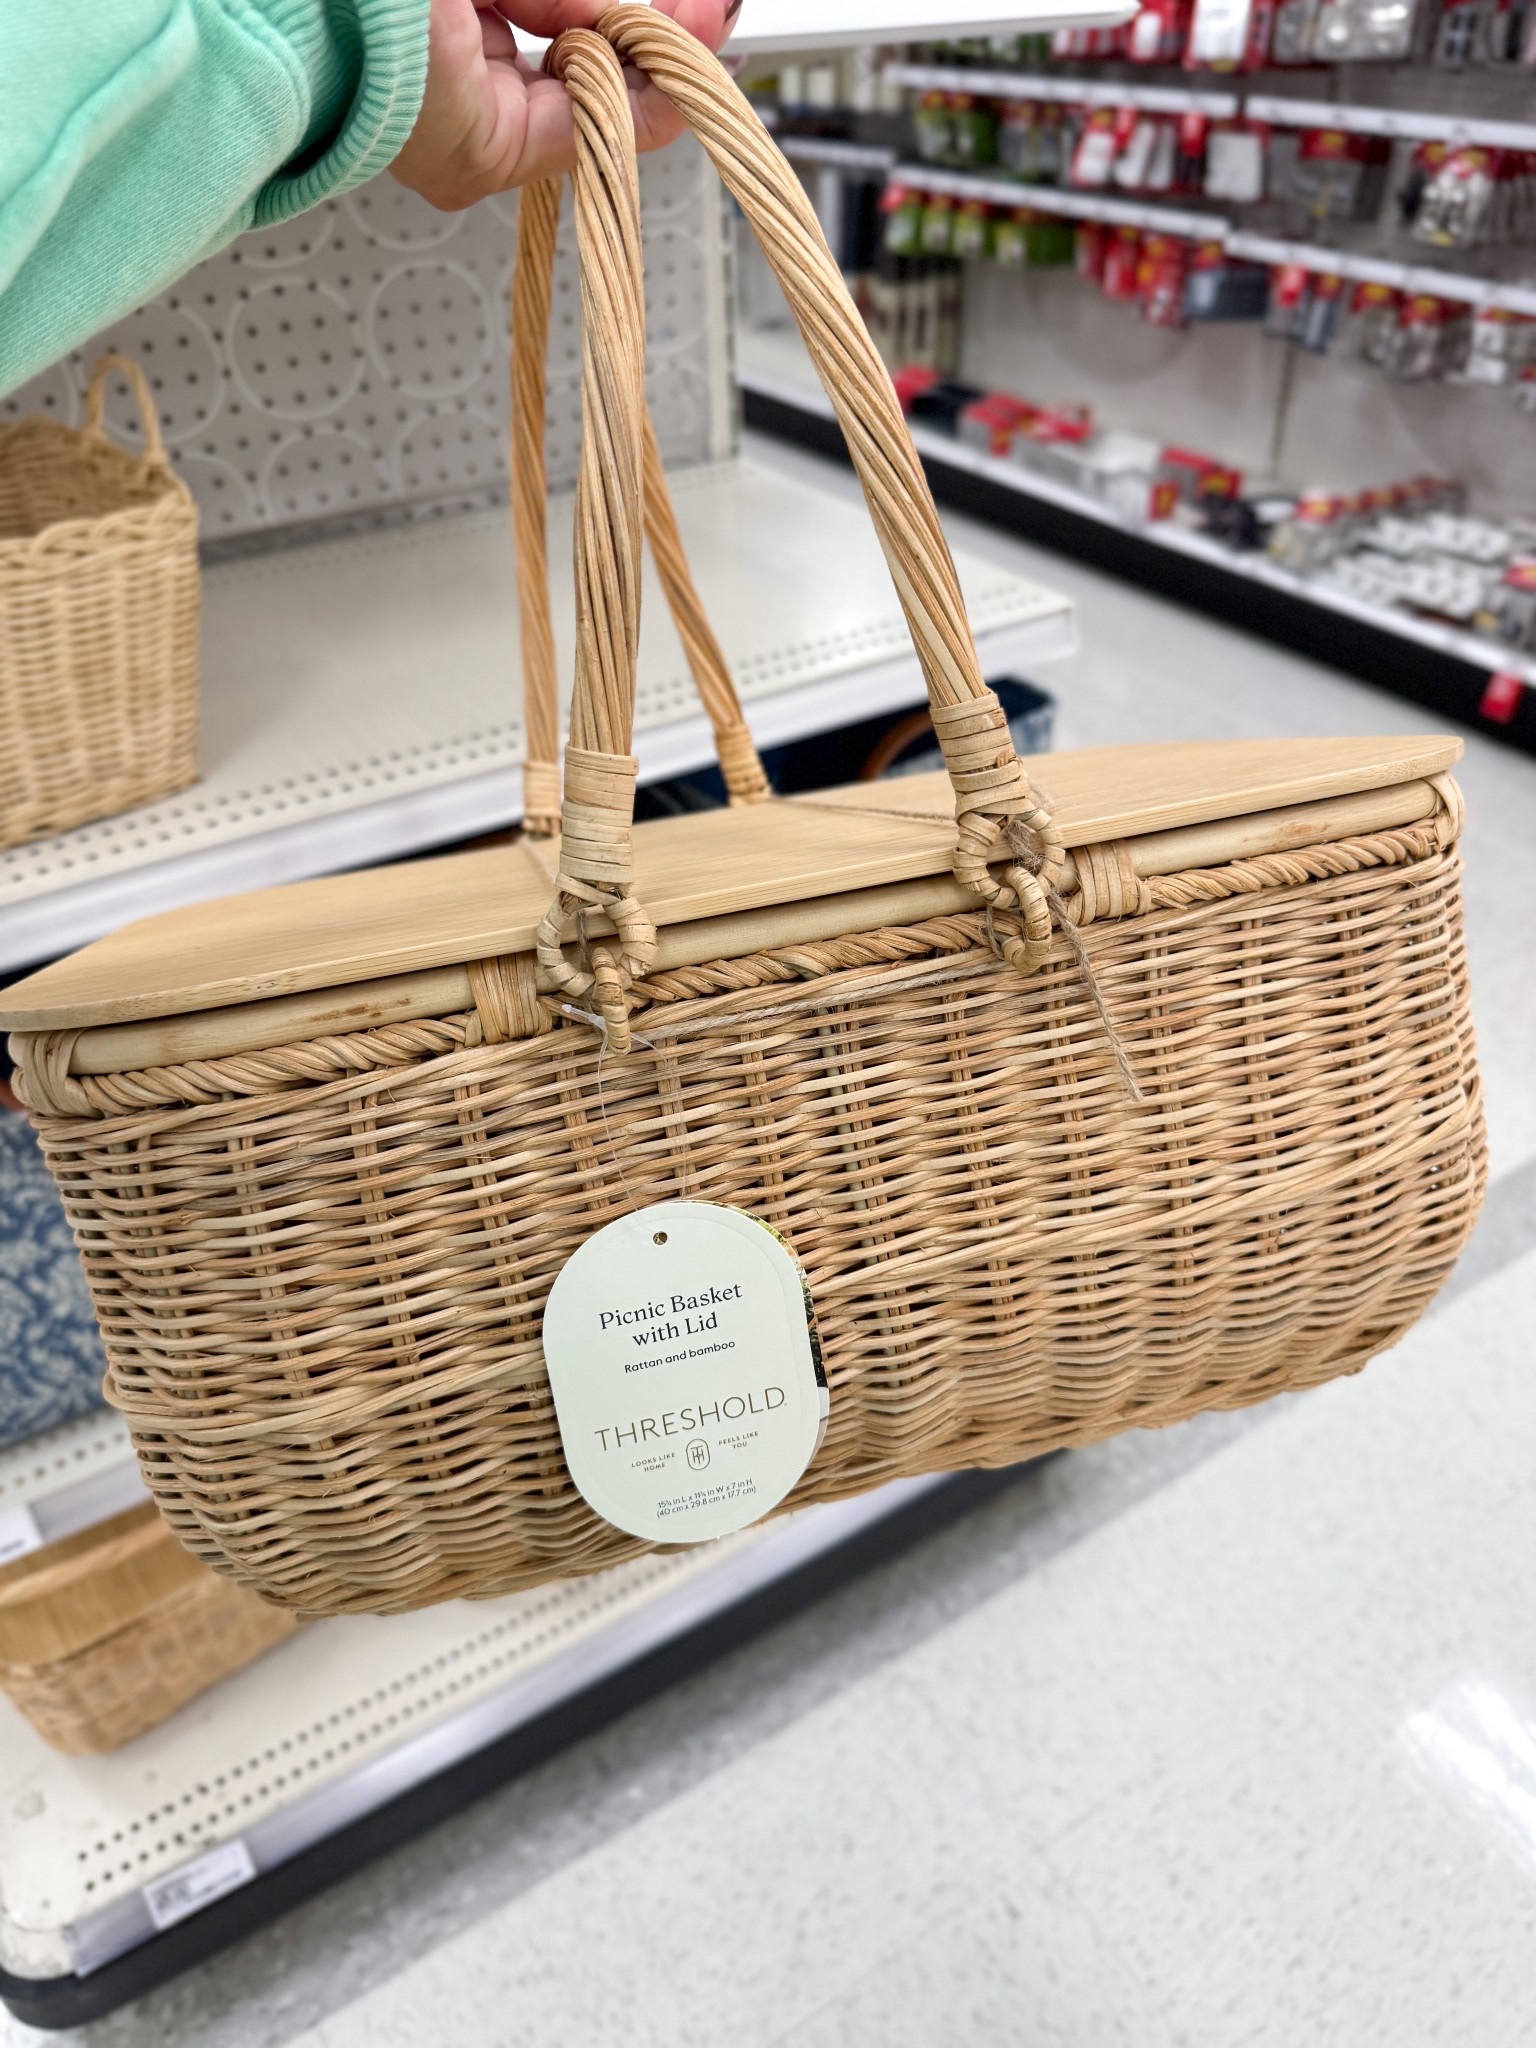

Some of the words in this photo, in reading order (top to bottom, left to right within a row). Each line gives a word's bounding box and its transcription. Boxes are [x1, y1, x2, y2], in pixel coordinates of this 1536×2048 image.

[598, 1301, 666, 1330] Picnic
[670, 1283, 743, 1314] Basket
[632, 1322, 680, 1347] with
[684, 1311, 718, 1335] Lid
[624, 1357, 663, 1374] Rattan
[665, 1350, 687, 1364] and
[689, 1340, 736, 1358] bamboo
[594, 1386, 786, 1452] THRESHOLD
[718, 1434, 740, 1446] FEELS
[742, 1430, 759, 1440] LIKE
[731, 1441, 748, 1450] YOU
[631, 1456, 657, 1468] LOOKS
[658, 1452, 676, 1461] LIKE
[644, 1462, 666, 1473] HOME
[656, 1507, 671, 1518] (40
[671, 1505, 684, 1513] cm
[690, 1497, 708, 1509] 29.8
[708, 1496, 721, 1504] cm
[727, 1489, 741, 1499] 17.7
[742, 1485, 757, 1495] cm)
[672, 1497, 681, 1505] in
[681, 1495, 687, 1503] L
[707, 1489, 715, 1497] in
[715, 1485, 724, 1493] W
[731, 1481, 736, 1489] 7
[737, 1480, 745, 1488] in
[746, 1477, 753, 1486] H
